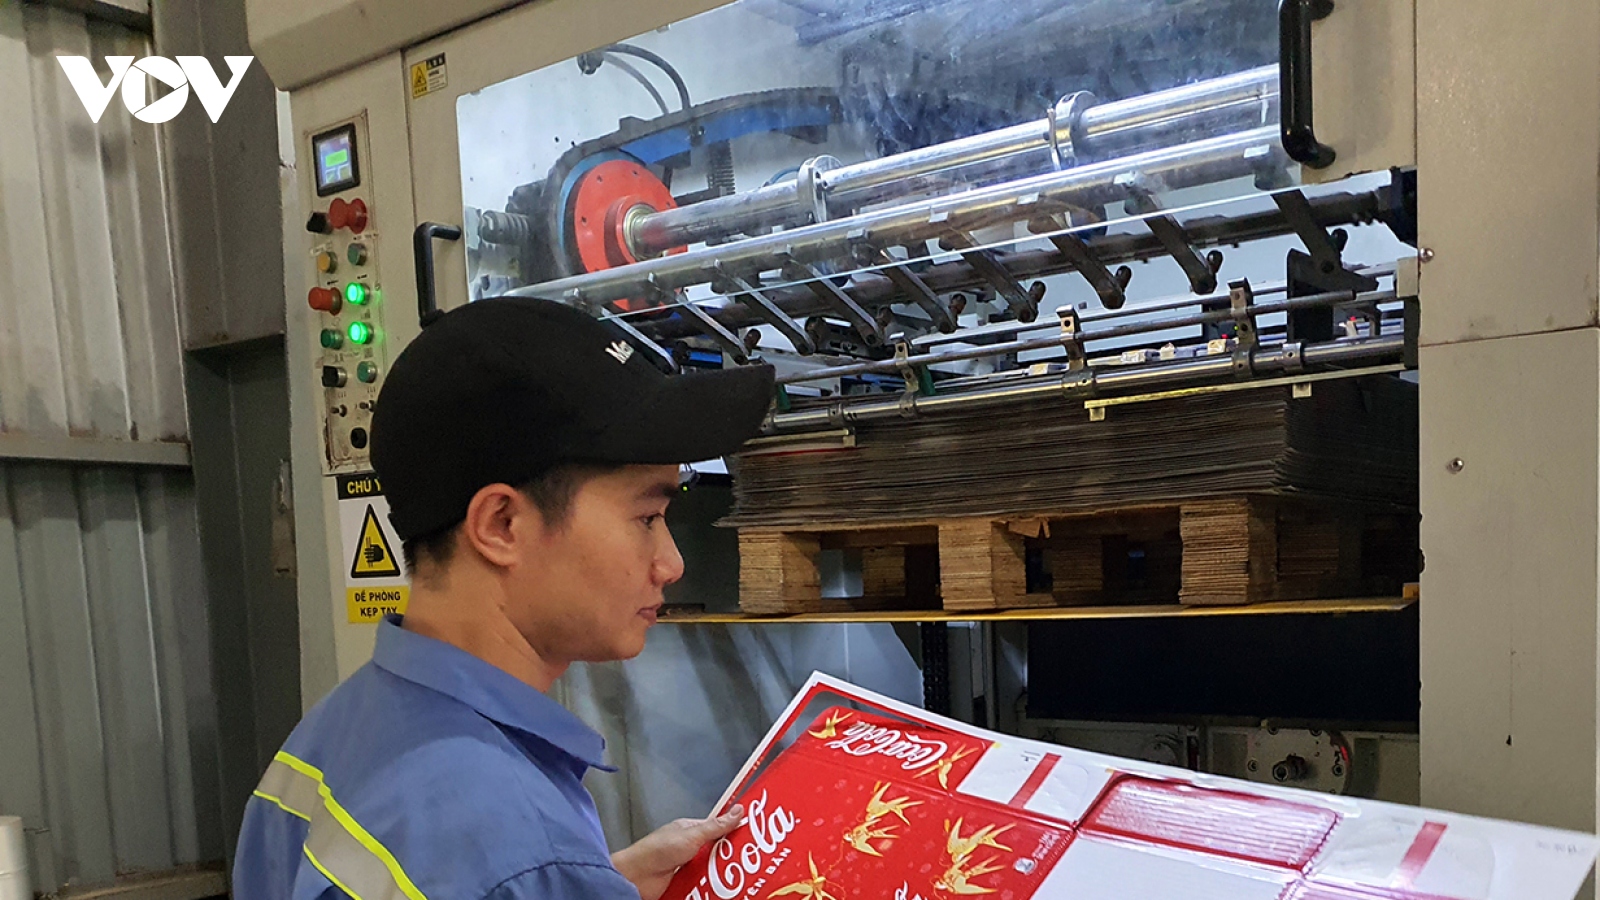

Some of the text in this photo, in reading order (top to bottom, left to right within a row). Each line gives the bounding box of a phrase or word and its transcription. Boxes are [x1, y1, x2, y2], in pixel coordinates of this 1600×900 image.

[347, 476, 371, 494] CHÚ
[369, 590, 401, 602] PHÒNG
[360, 606, 397, 618] KẸP TAY
